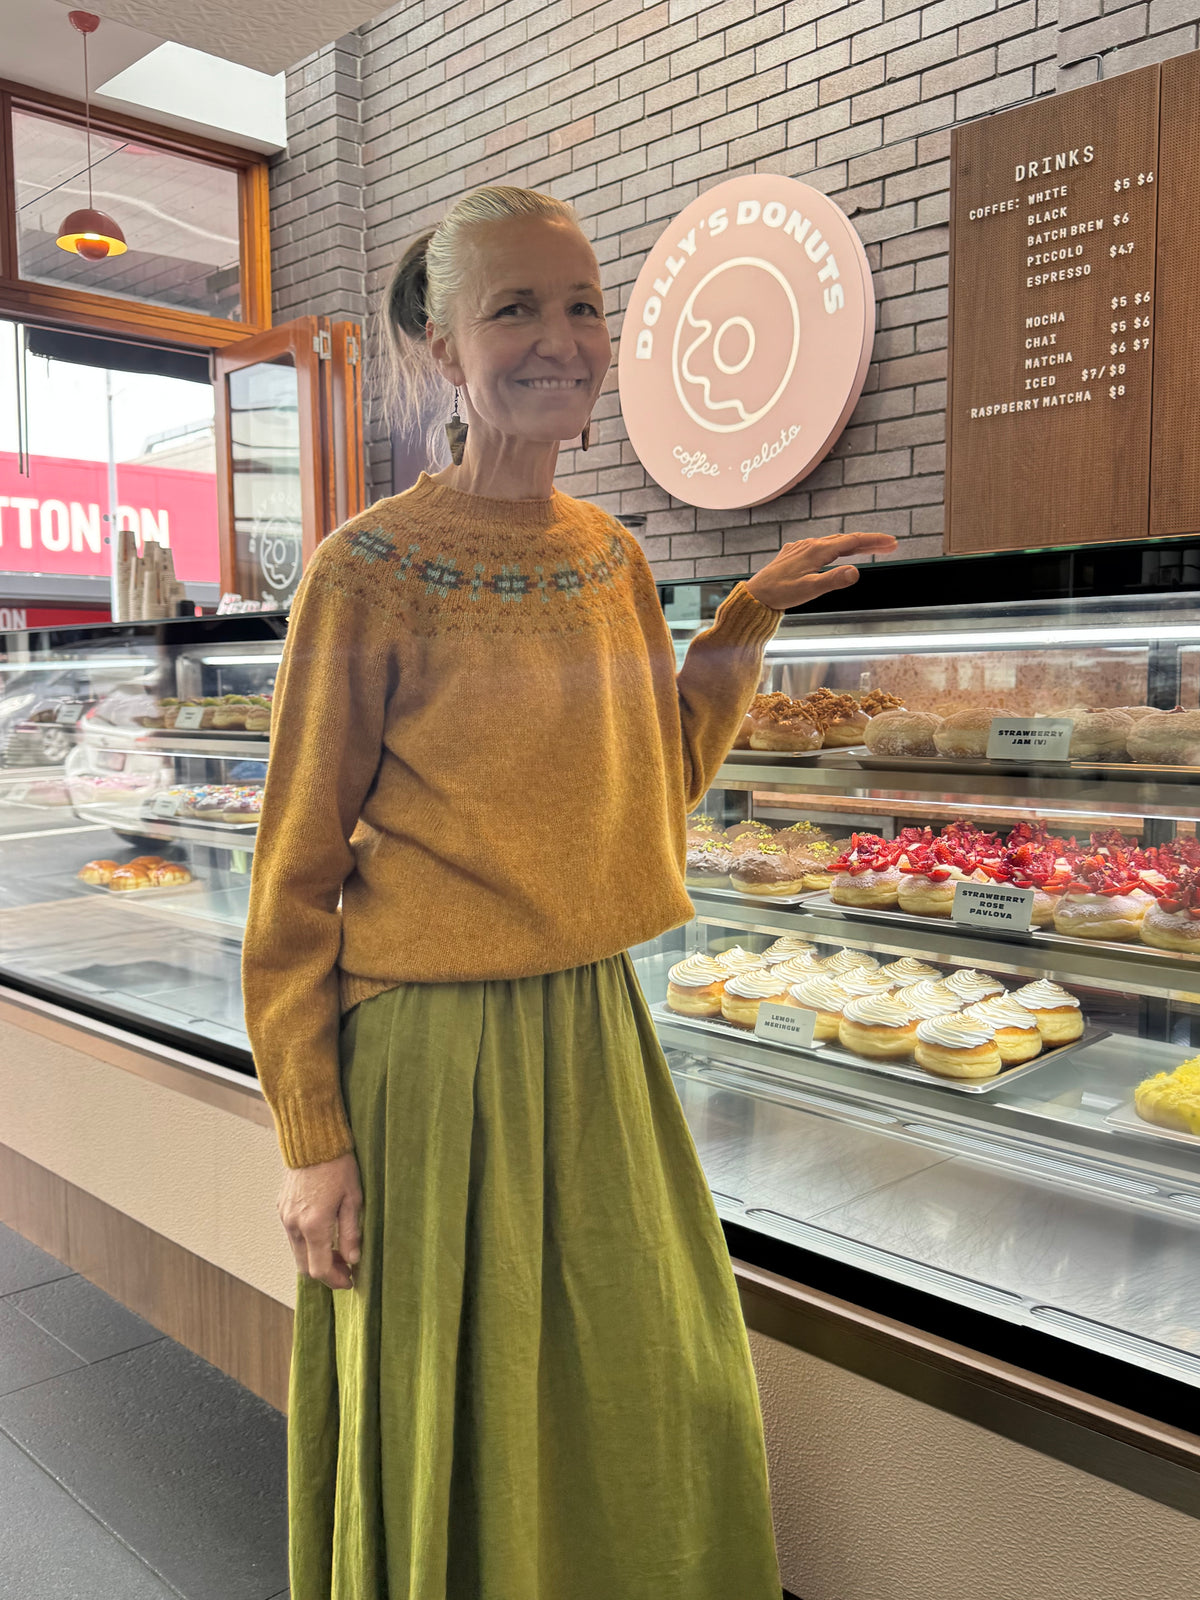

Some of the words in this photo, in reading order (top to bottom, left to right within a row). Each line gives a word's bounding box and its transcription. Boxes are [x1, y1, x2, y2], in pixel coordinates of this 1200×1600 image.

[1015, 145, 1094, 182] DRINKS
[969, 198, 1020, 220] COFFEE:
[1028, 186, 1068, 205] WHITE
[1114, 178, 1130, 192] $5
[1137, 172, 1154, 185] $6
[1027, 228, 1067, 246] BATCH
[1071, 219, 1104, 236] BREW
[1113, 213, 1129, 226] $6
[1028, 207, 1068, 225] BLACK
[1027, 245, 1083, 267] PICCOLO
[636, 208, 728, 359] DOLLY'S
[737, 200, 845, 315] DONUTS
[1027, 264, 1091, 288] ESPRESSO
[1026, 312, 1065, 329] MOCHA
[1111, 297, 1127, 309] $5
[1134, 292, 1150, 305] $6
[1025, 334, 1057, 349] CHAI
[1110, 321, 1126, 334] $5
[1134, 316, 1150, 329] $6
[1025, 352, 1072, 369] MATCHA
[1110, 342, 1126, 355] $6
[1133, 339, 1149, 351] $7
[1025, 376, 1056, 389] ICED
[971, 399, 1039, 419] RASPBERRY
[1043, 391, 1091, 407] MATCHA
[1109, 385, 1125, 399] $8
[672, 446, 721, 479] coffee
[740, 424, 802, 482] gelato
[962, 890, 1026, 903] STRAWBERRY
[979, 901, 1004, 909] ROSE
[969, 908, 1012, 919] PAVLOVA
[764, 1020, 801, 1032] MERINGUE
[771, 1014, 795, 1023] LEMON
